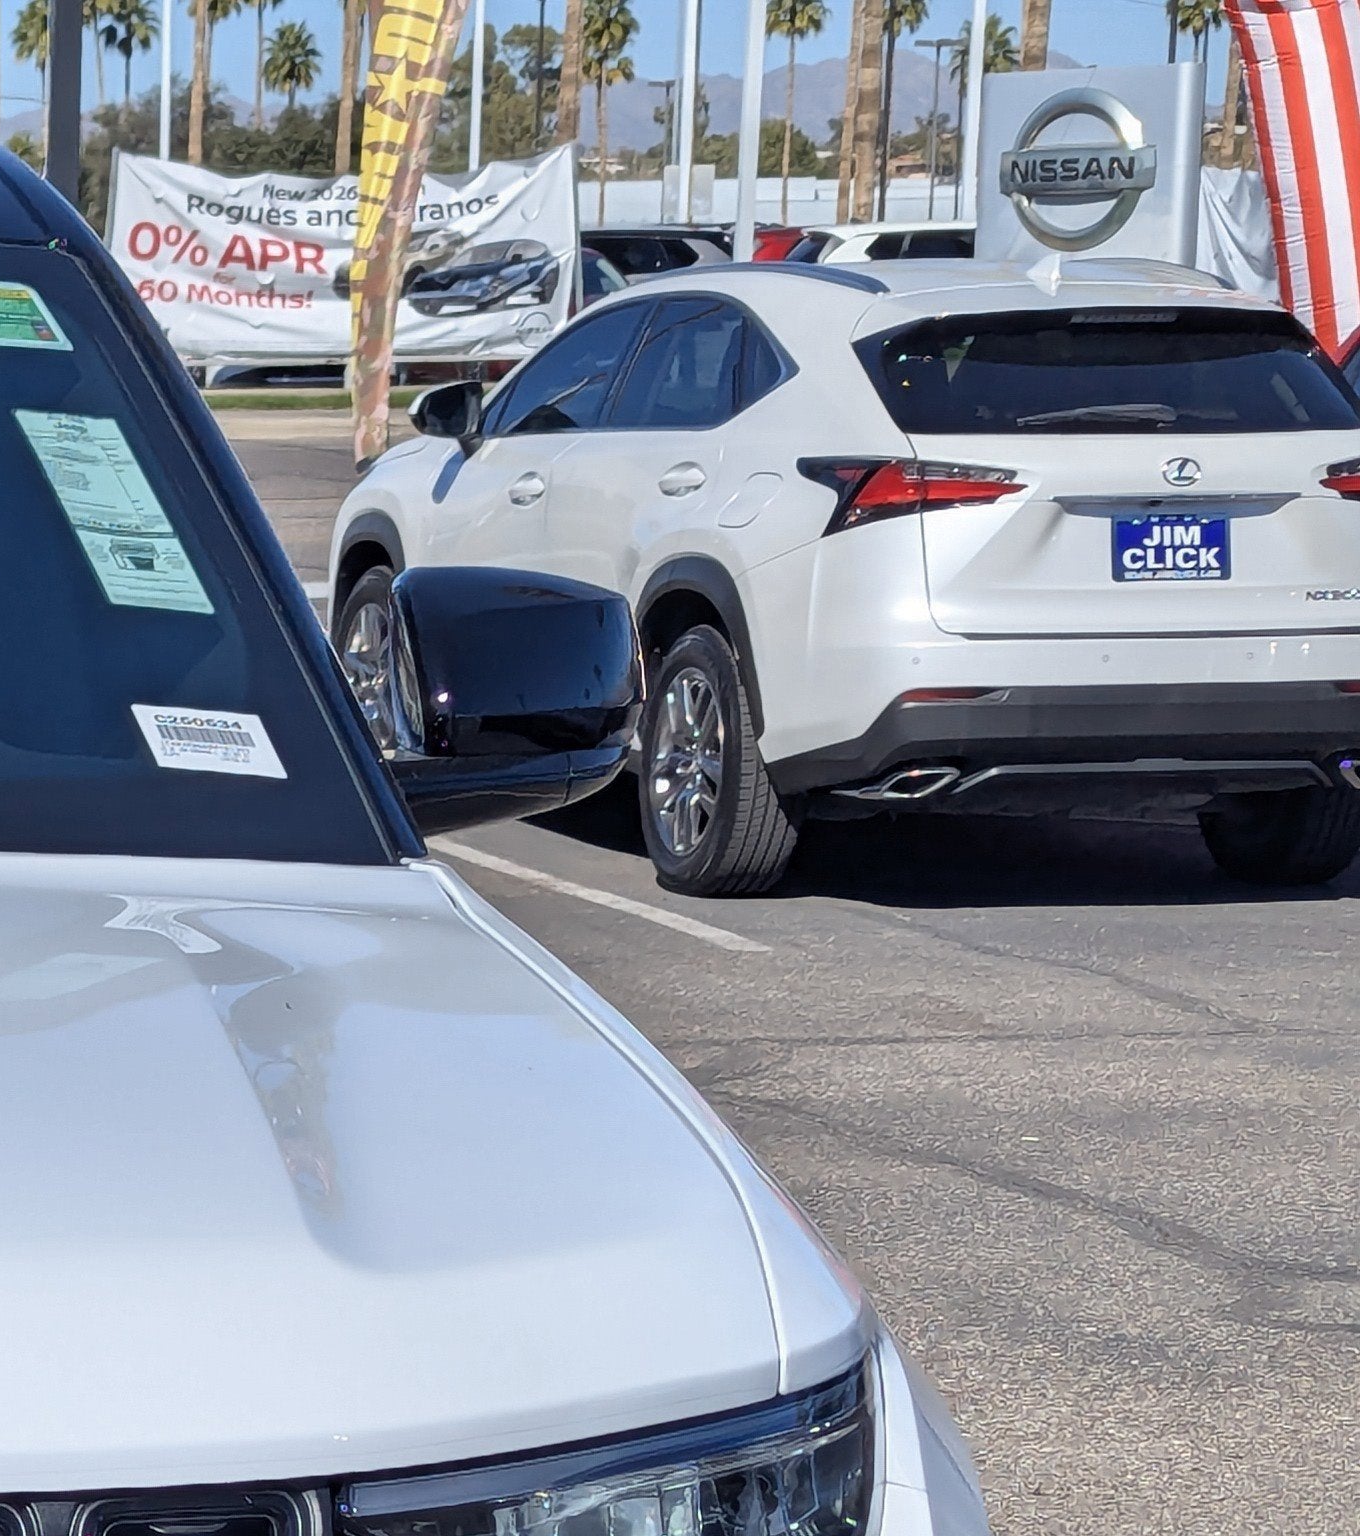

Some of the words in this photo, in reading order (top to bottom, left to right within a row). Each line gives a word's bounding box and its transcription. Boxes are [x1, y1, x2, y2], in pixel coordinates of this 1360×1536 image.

[1010, 155, 1136, 184] NISSAN
[263, 183, 306, 201] New
[310, 185, 359, 202] 2026
[186, 193, 298, 226] Rogues
[418, 192, 500, 223] ranos
[127, 221, 209, 268] 0%
[216, 233, 329, 275] APR
[212, 271, 237, 285] for
[137, 278, 179, 304] 60
[185, 283, 314, 309] Months!
[1142, 525, 1201, 547] JIM
[1122, 547, 1221, 569] CLICK
